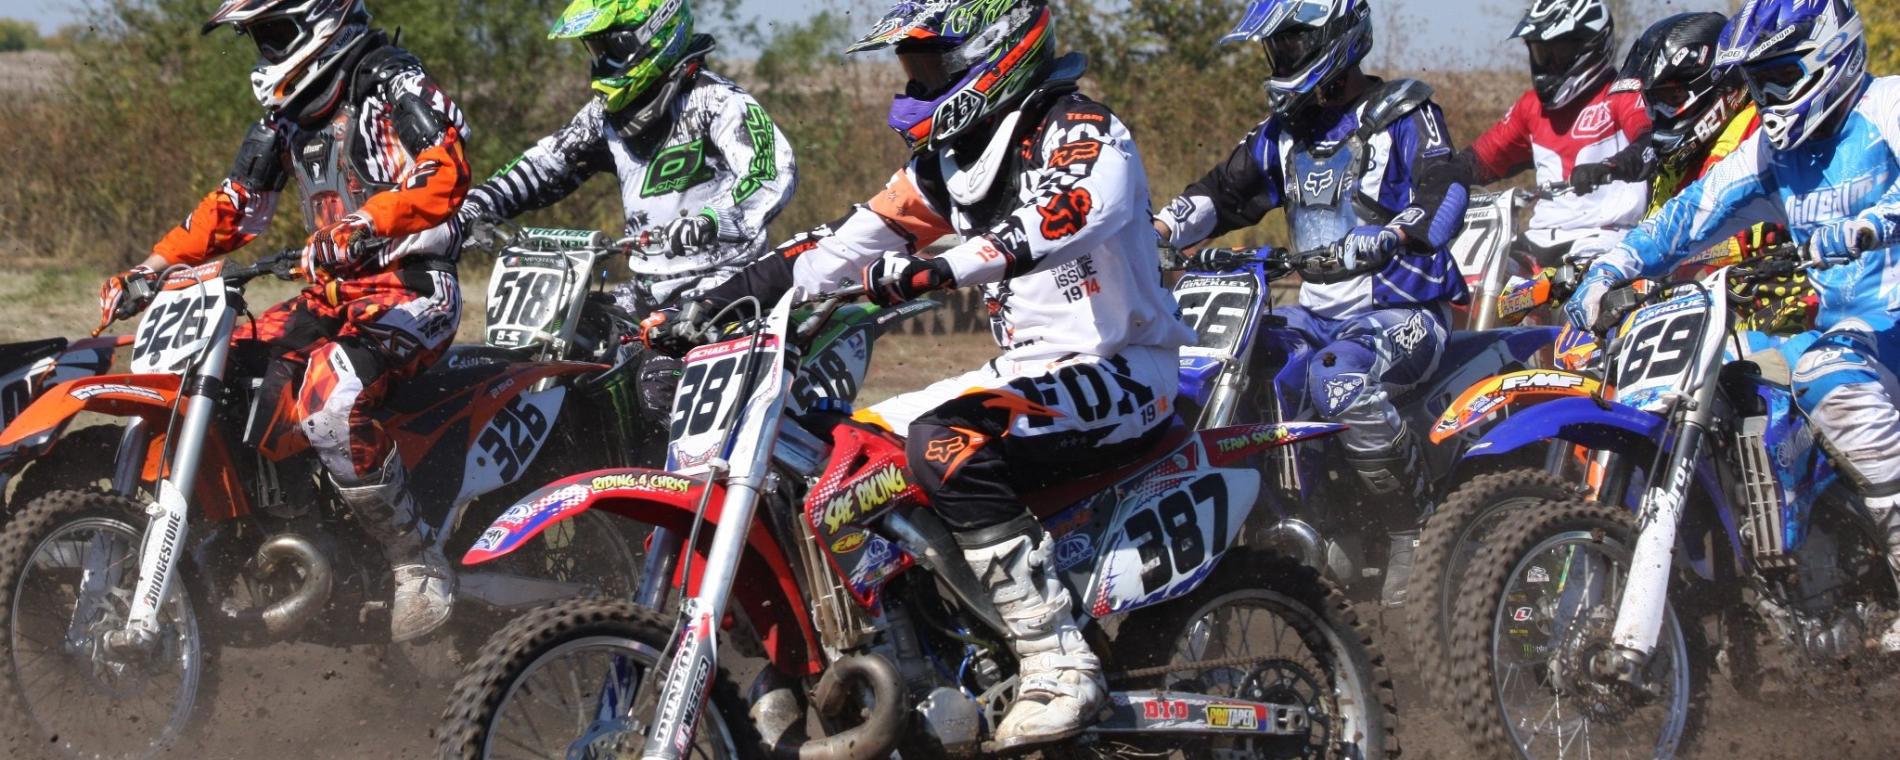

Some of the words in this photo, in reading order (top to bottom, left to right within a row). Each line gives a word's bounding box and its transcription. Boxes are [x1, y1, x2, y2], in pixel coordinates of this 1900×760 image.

[1694, 98, 1727, 142] 827
[655, 176, 688, 193] ONE
[1002, 227, 1029, 250] 74
[487, 270, 562, 327] 518
[1054, 260, 1097, 289] ISSUE
[1062, 278, 1102, 304] 1974
[133, 296, 219, 360] 326
[1618, 313, 1703, 390] 69
[1008, 354, 1154, 428] FOX
[1502, 373, 1584, 390] FMF
[478, 391, 548, 484] 326
[650, 475, 691, 493] CHRIST
[855, 462, 908, 513] RACING
[144, 511, 181, 610] BRIDGESTONE
[1125, 473, 1229, 596] 387
[655, 630, 699, 747] DUNLOP
